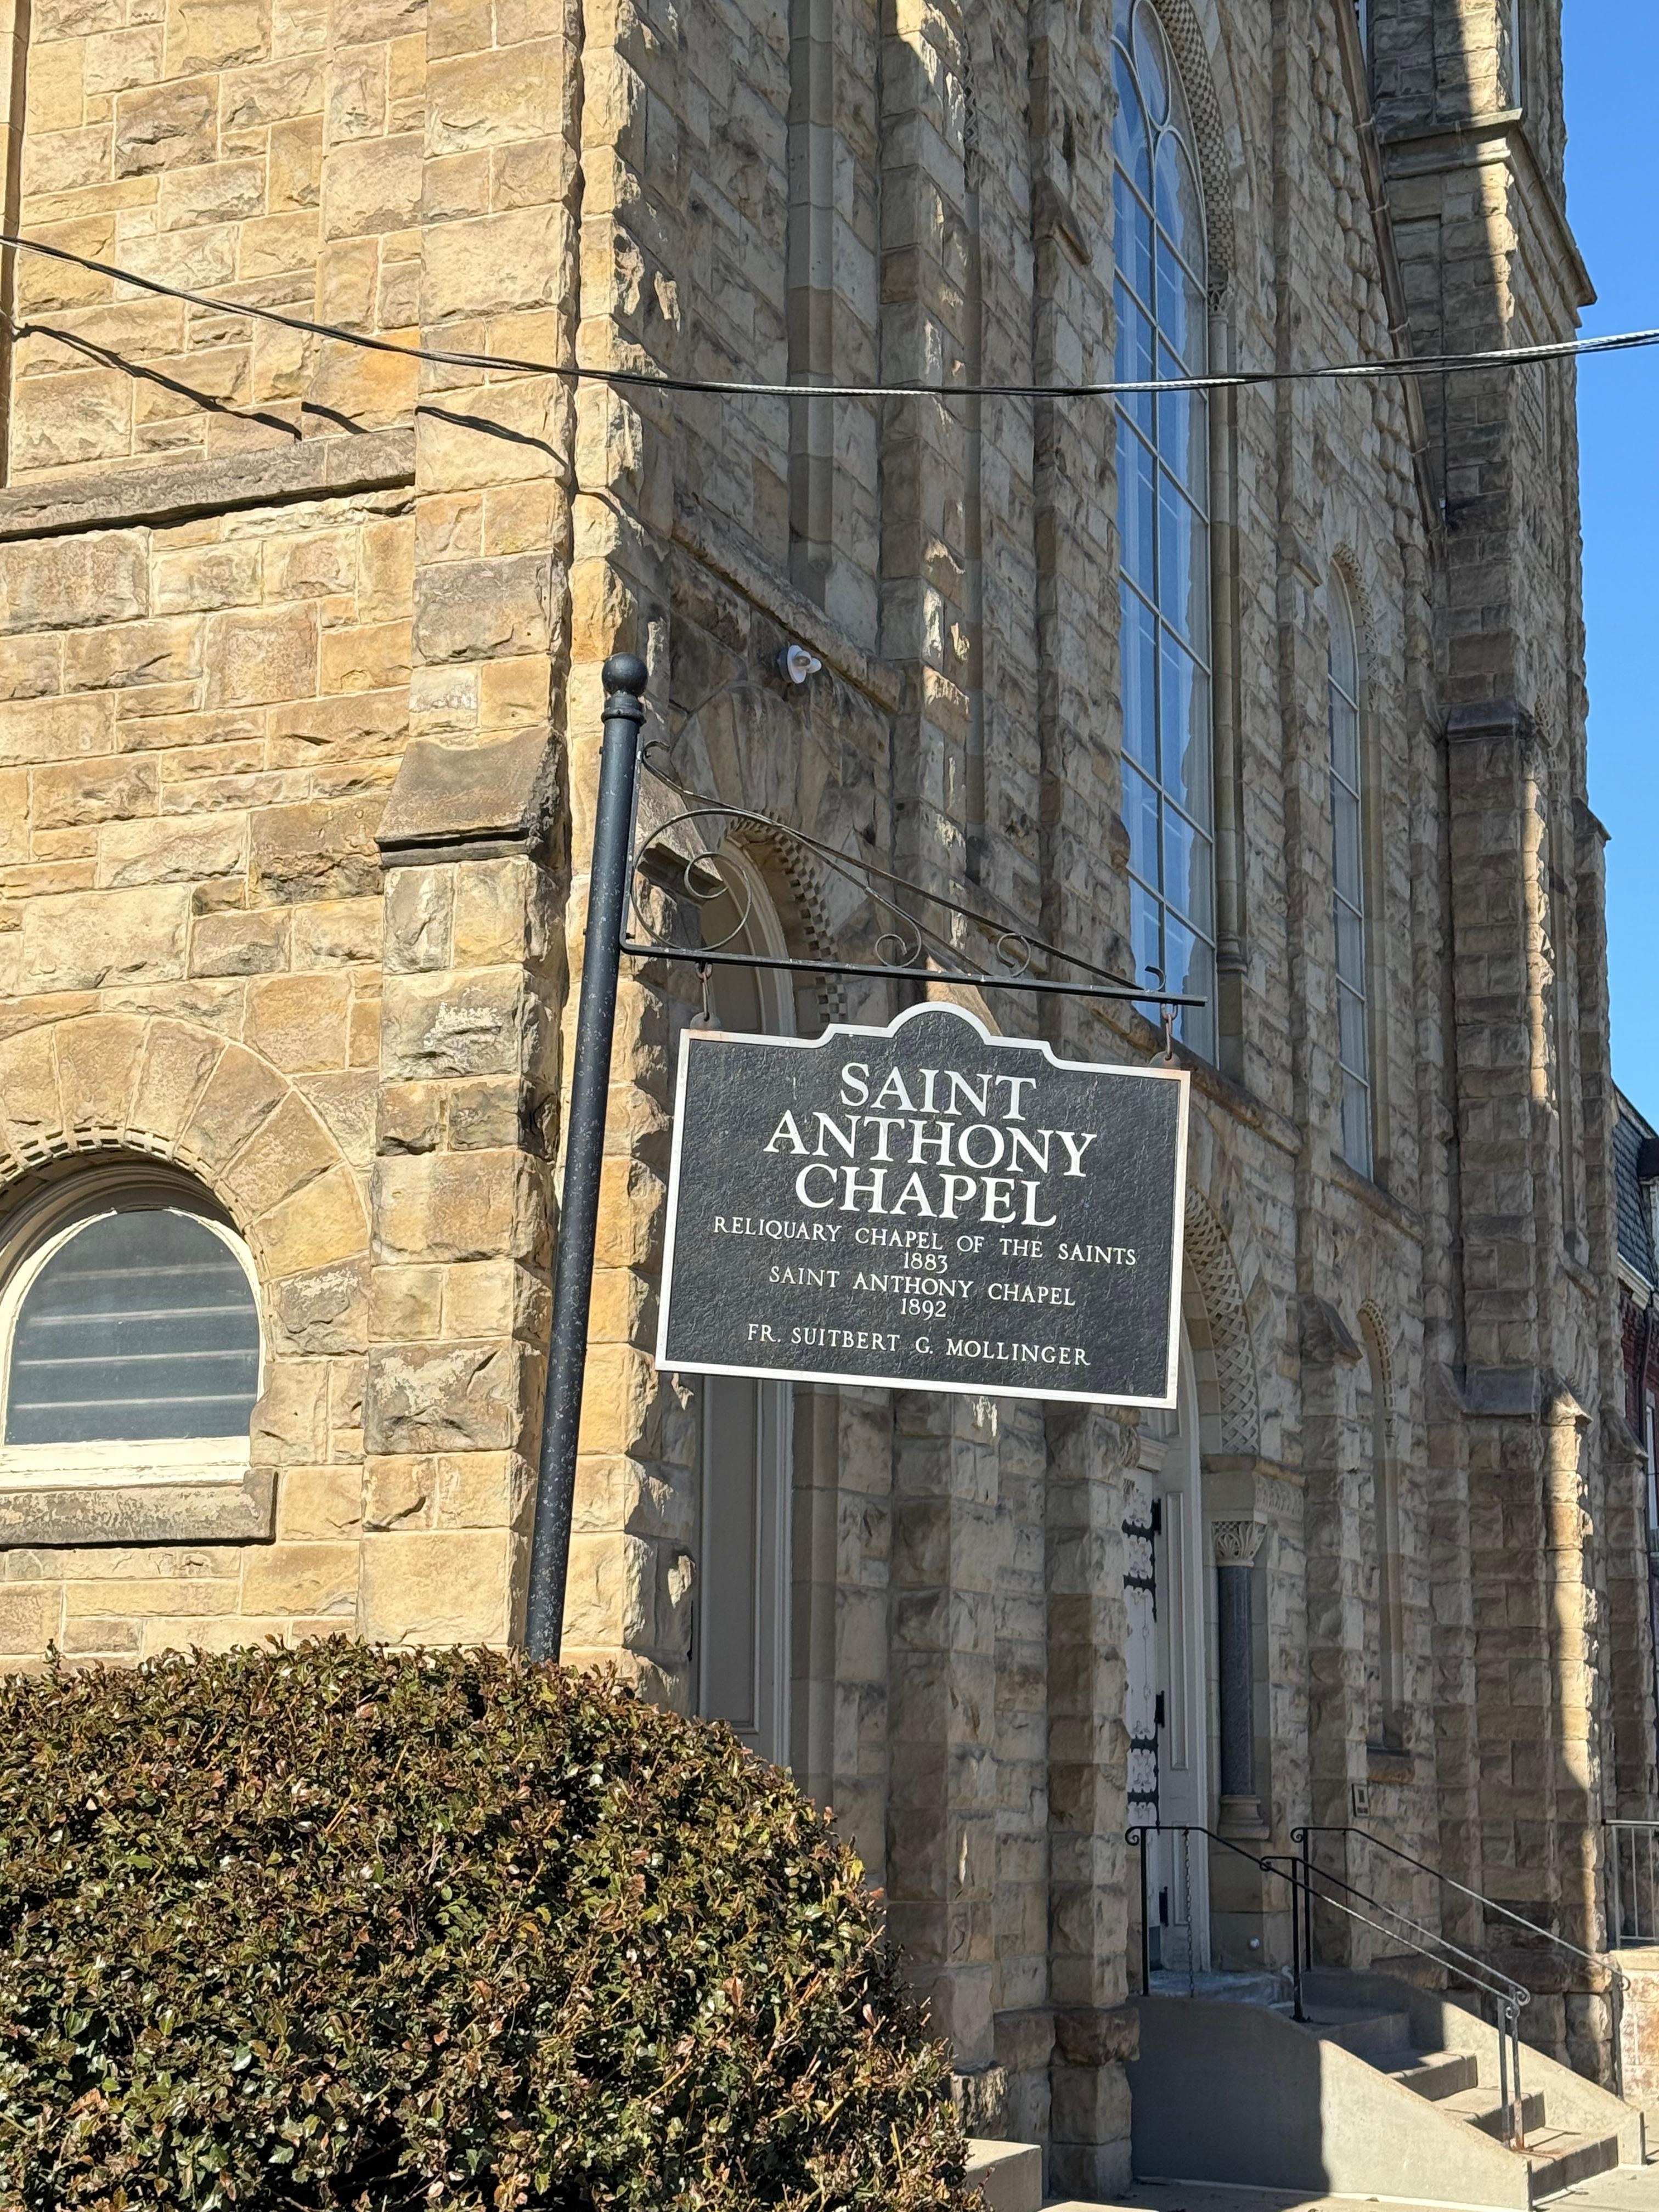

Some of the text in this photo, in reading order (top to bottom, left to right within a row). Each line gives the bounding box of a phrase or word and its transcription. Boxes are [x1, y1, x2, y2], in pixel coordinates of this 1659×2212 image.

[840, 1062, 1037, 1121] SAINT
[763, 1109, 1098, 1177] ANTHONY
[795, 1163, 1057, 1227] CHAPEL
[713, 1216, 1137, 1266] RELIQUARY CHAPEL OF THE SAINTS
[903, 1250, 949, 1274] 1883
[769, 1265, 1076, 1307] SAINT ANTHONY CHAPEL
[900, 1297, 947, 1321] 1892
[747, 1323, 1092, 1367] FR. SUITBERT G. MOLLINGER
